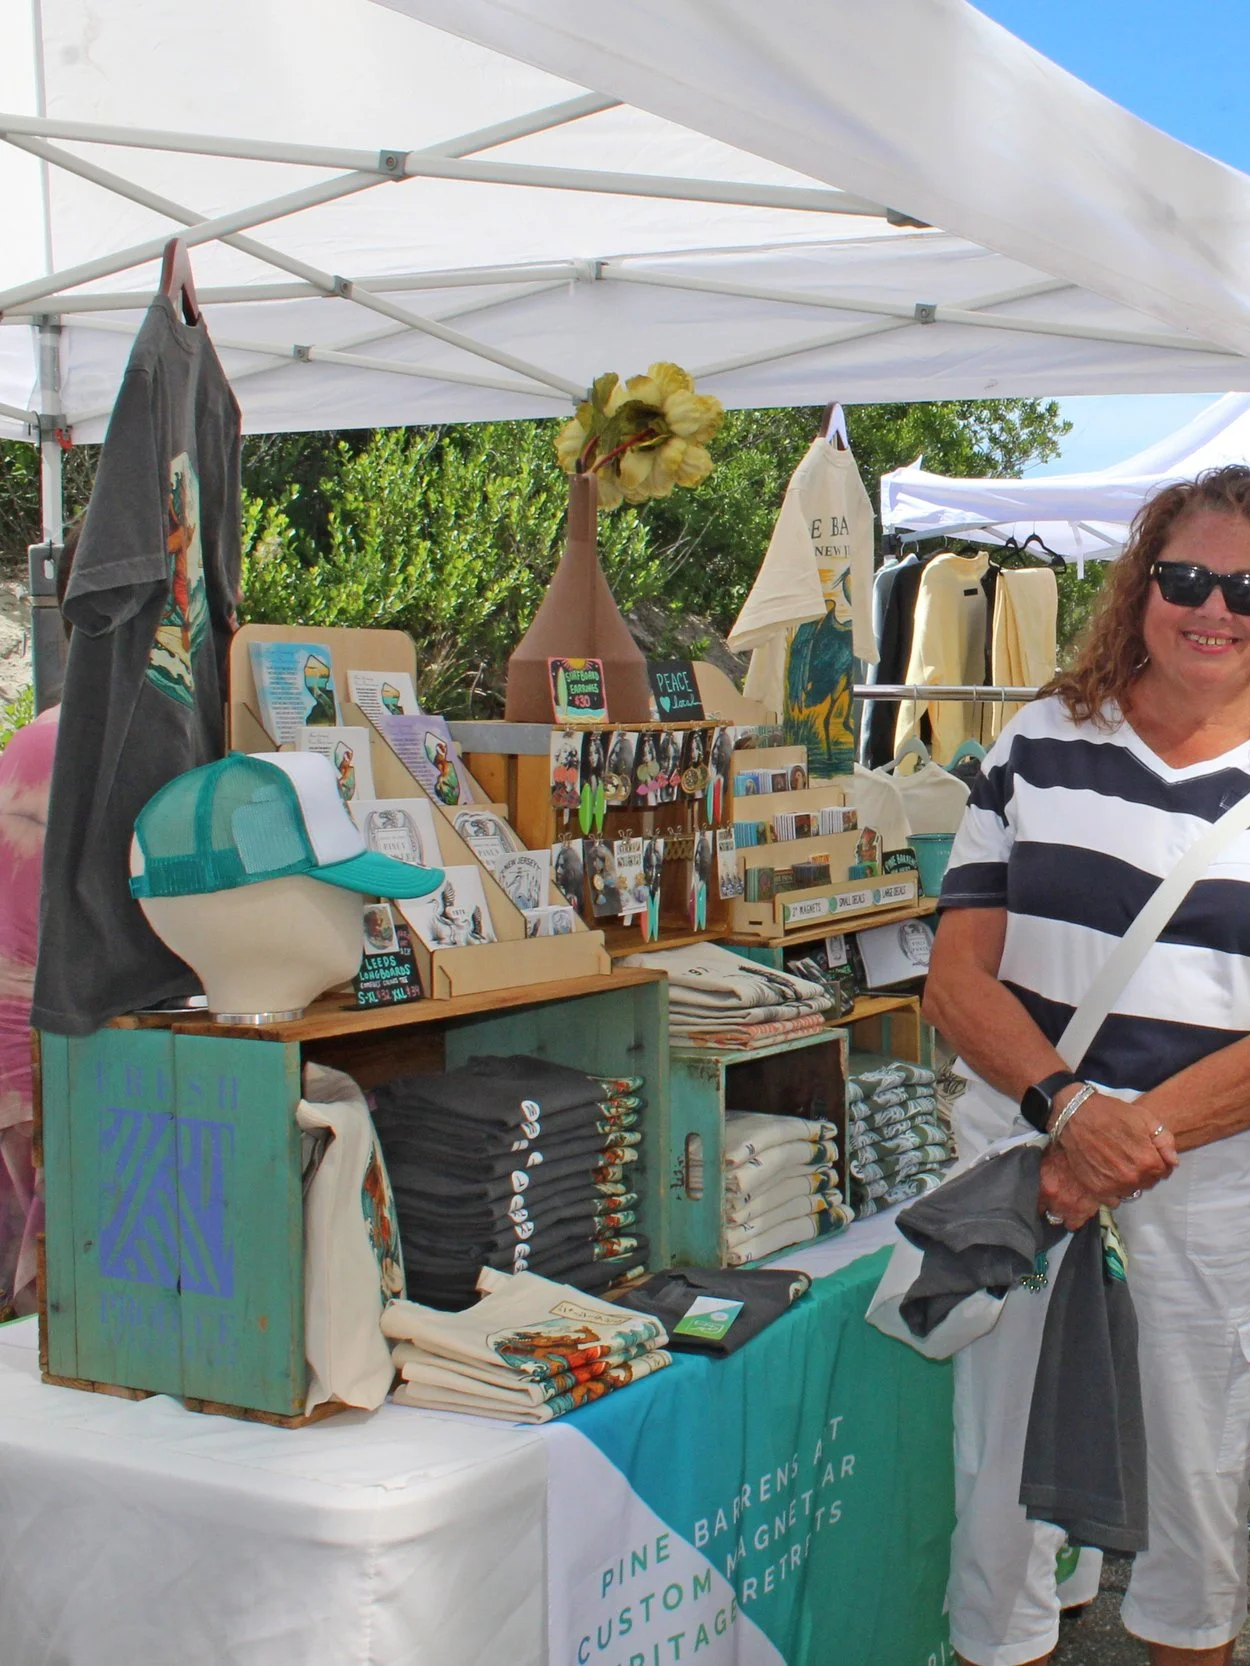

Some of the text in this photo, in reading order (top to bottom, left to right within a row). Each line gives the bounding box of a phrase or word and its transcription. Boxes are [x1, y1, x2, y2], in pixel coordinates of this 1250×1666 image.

[831, 515, 849, 537] BA
[815, 545, 841, 557] NEW
[565, 670, 600, 682] SURFBOARD
[656, 671, 693, 693] PEACE
[574, 694, 591, 708] $30
[503, 859, 516, 870] NEW
[516, 855, 542, 871] JERSEY
[365, 955, 397, 970] LEEDS
[360, 963, 411, 981] LONGBOARDS
[357, 991, 379, 1005] S-XL
[392, 987, 408, 1002] XXL
[601, 1533, 671, 1599] PINE
[694, 1452, 799, 1548] BARRENS
[577, 1567, 712, 1665] CUSTOM
[726, 1489, 814, 1580] MAGNET
